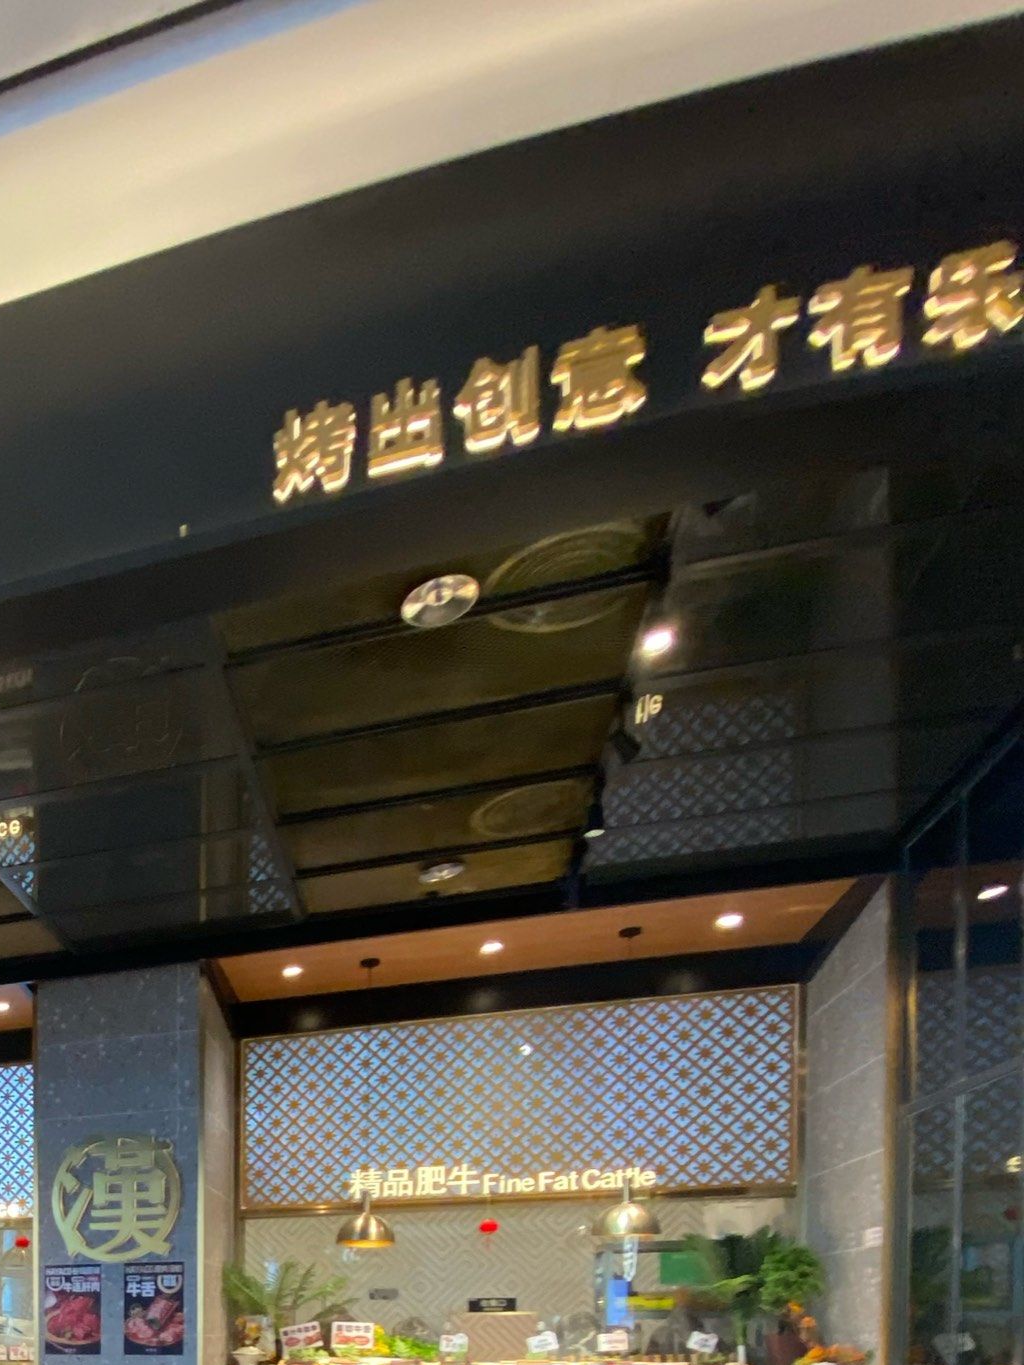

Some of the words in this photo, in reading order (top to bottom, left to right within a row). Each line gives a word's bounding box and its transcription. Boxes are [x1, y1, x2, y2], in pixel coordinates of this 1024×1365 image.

[273, 325, 649, 503] 烤出创意
[349, 1164, 480, 1200] 精品肥牛
[482, 1173, 534, 1195] Fine
[538, 1170, 579, 1192] Fat
[581, 1167, 657, 1191] Cattle
